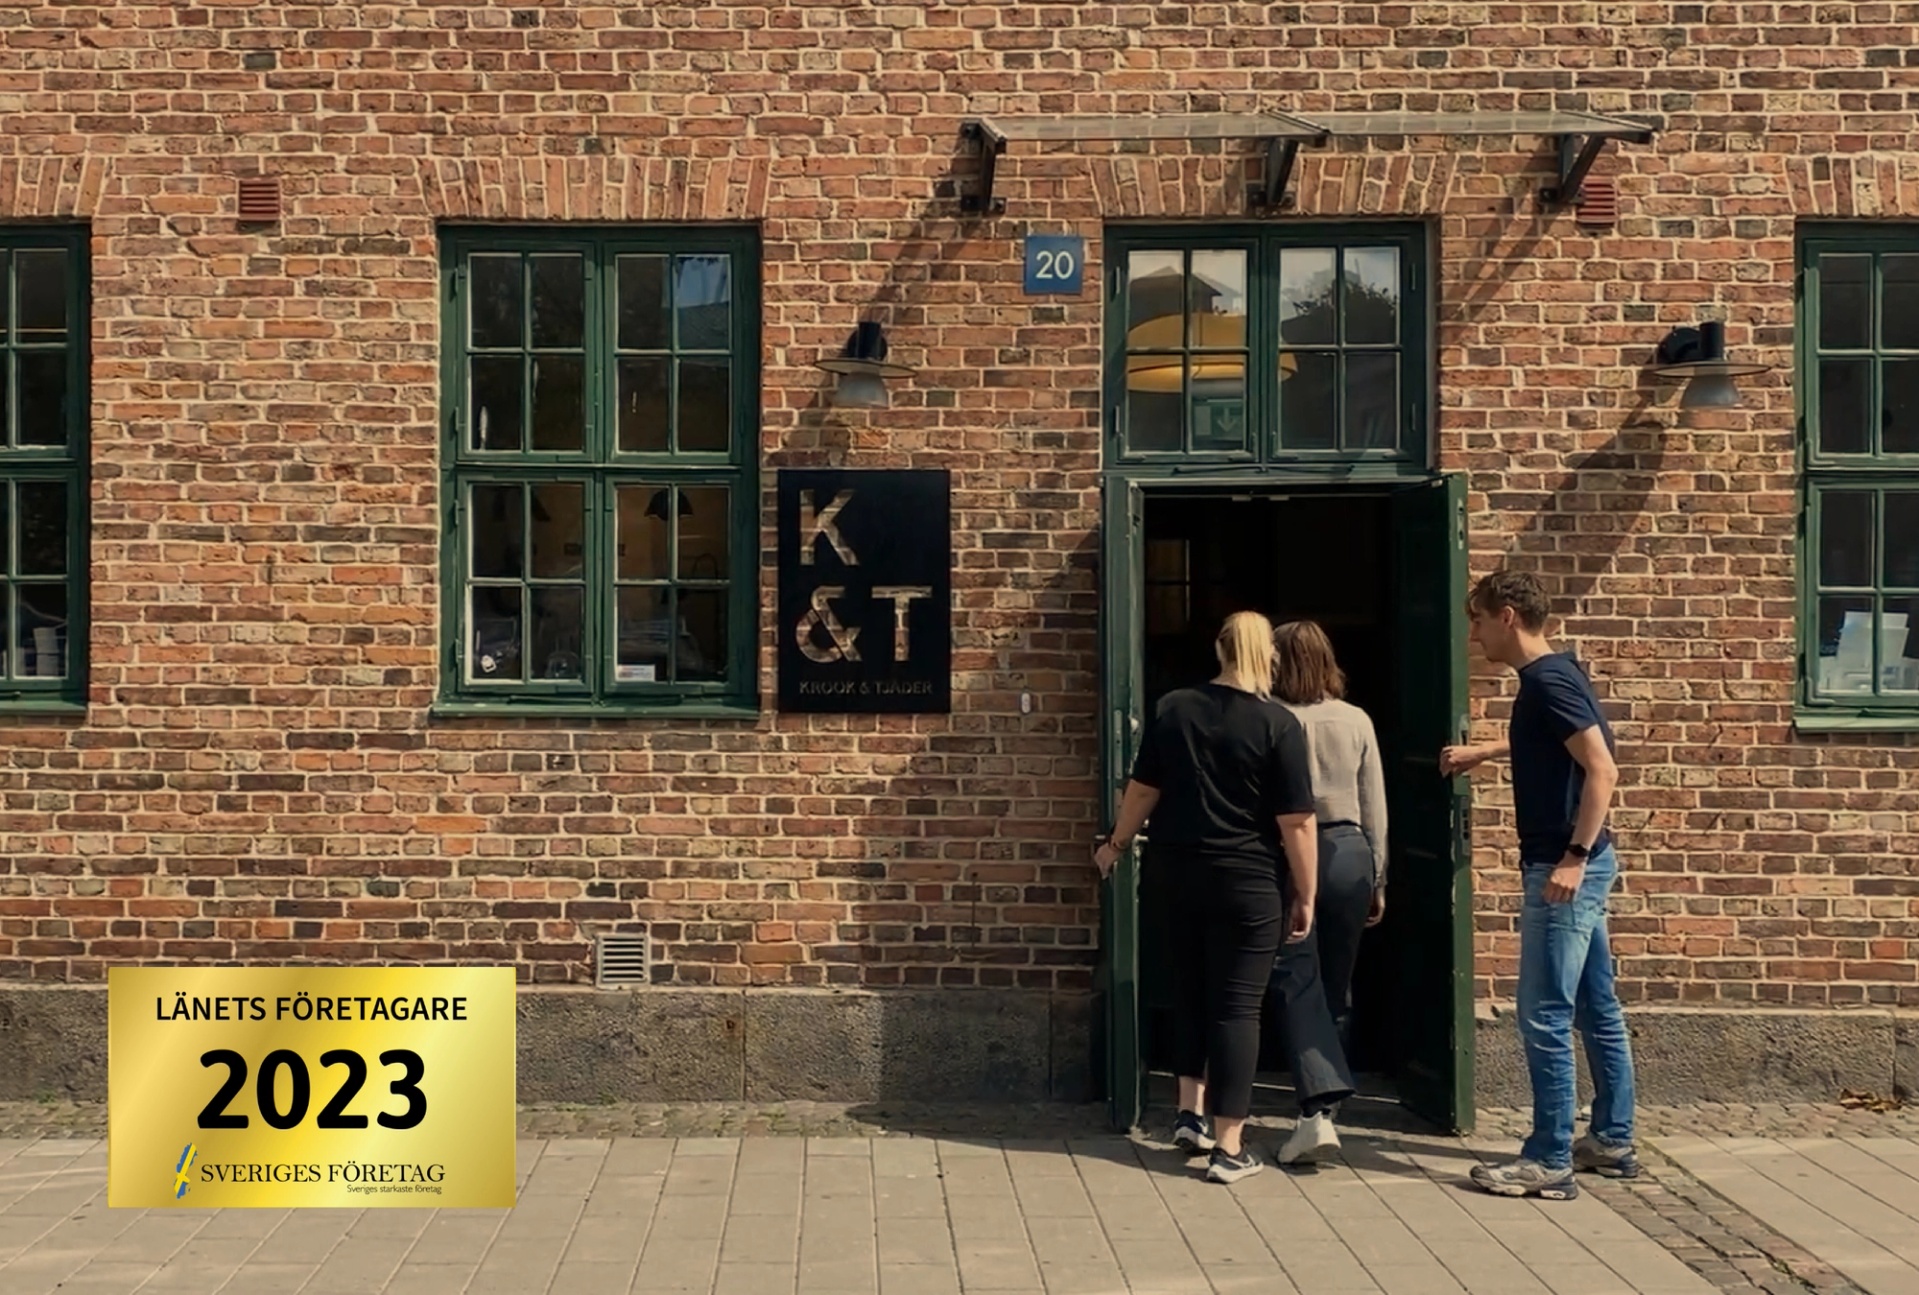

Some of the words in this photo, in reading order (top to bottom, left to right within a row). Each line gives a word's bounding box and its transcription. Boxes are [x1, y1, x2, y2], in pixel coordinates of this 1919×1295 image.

[1036, 250, 1074, 280] 20
[799, 489, 860, 566] K
[795, 585, 862, 663] &
[871, 585, 933, 662] T
[799, 681, 856, 695] KROOK
[859, 681, 870, 695] &
